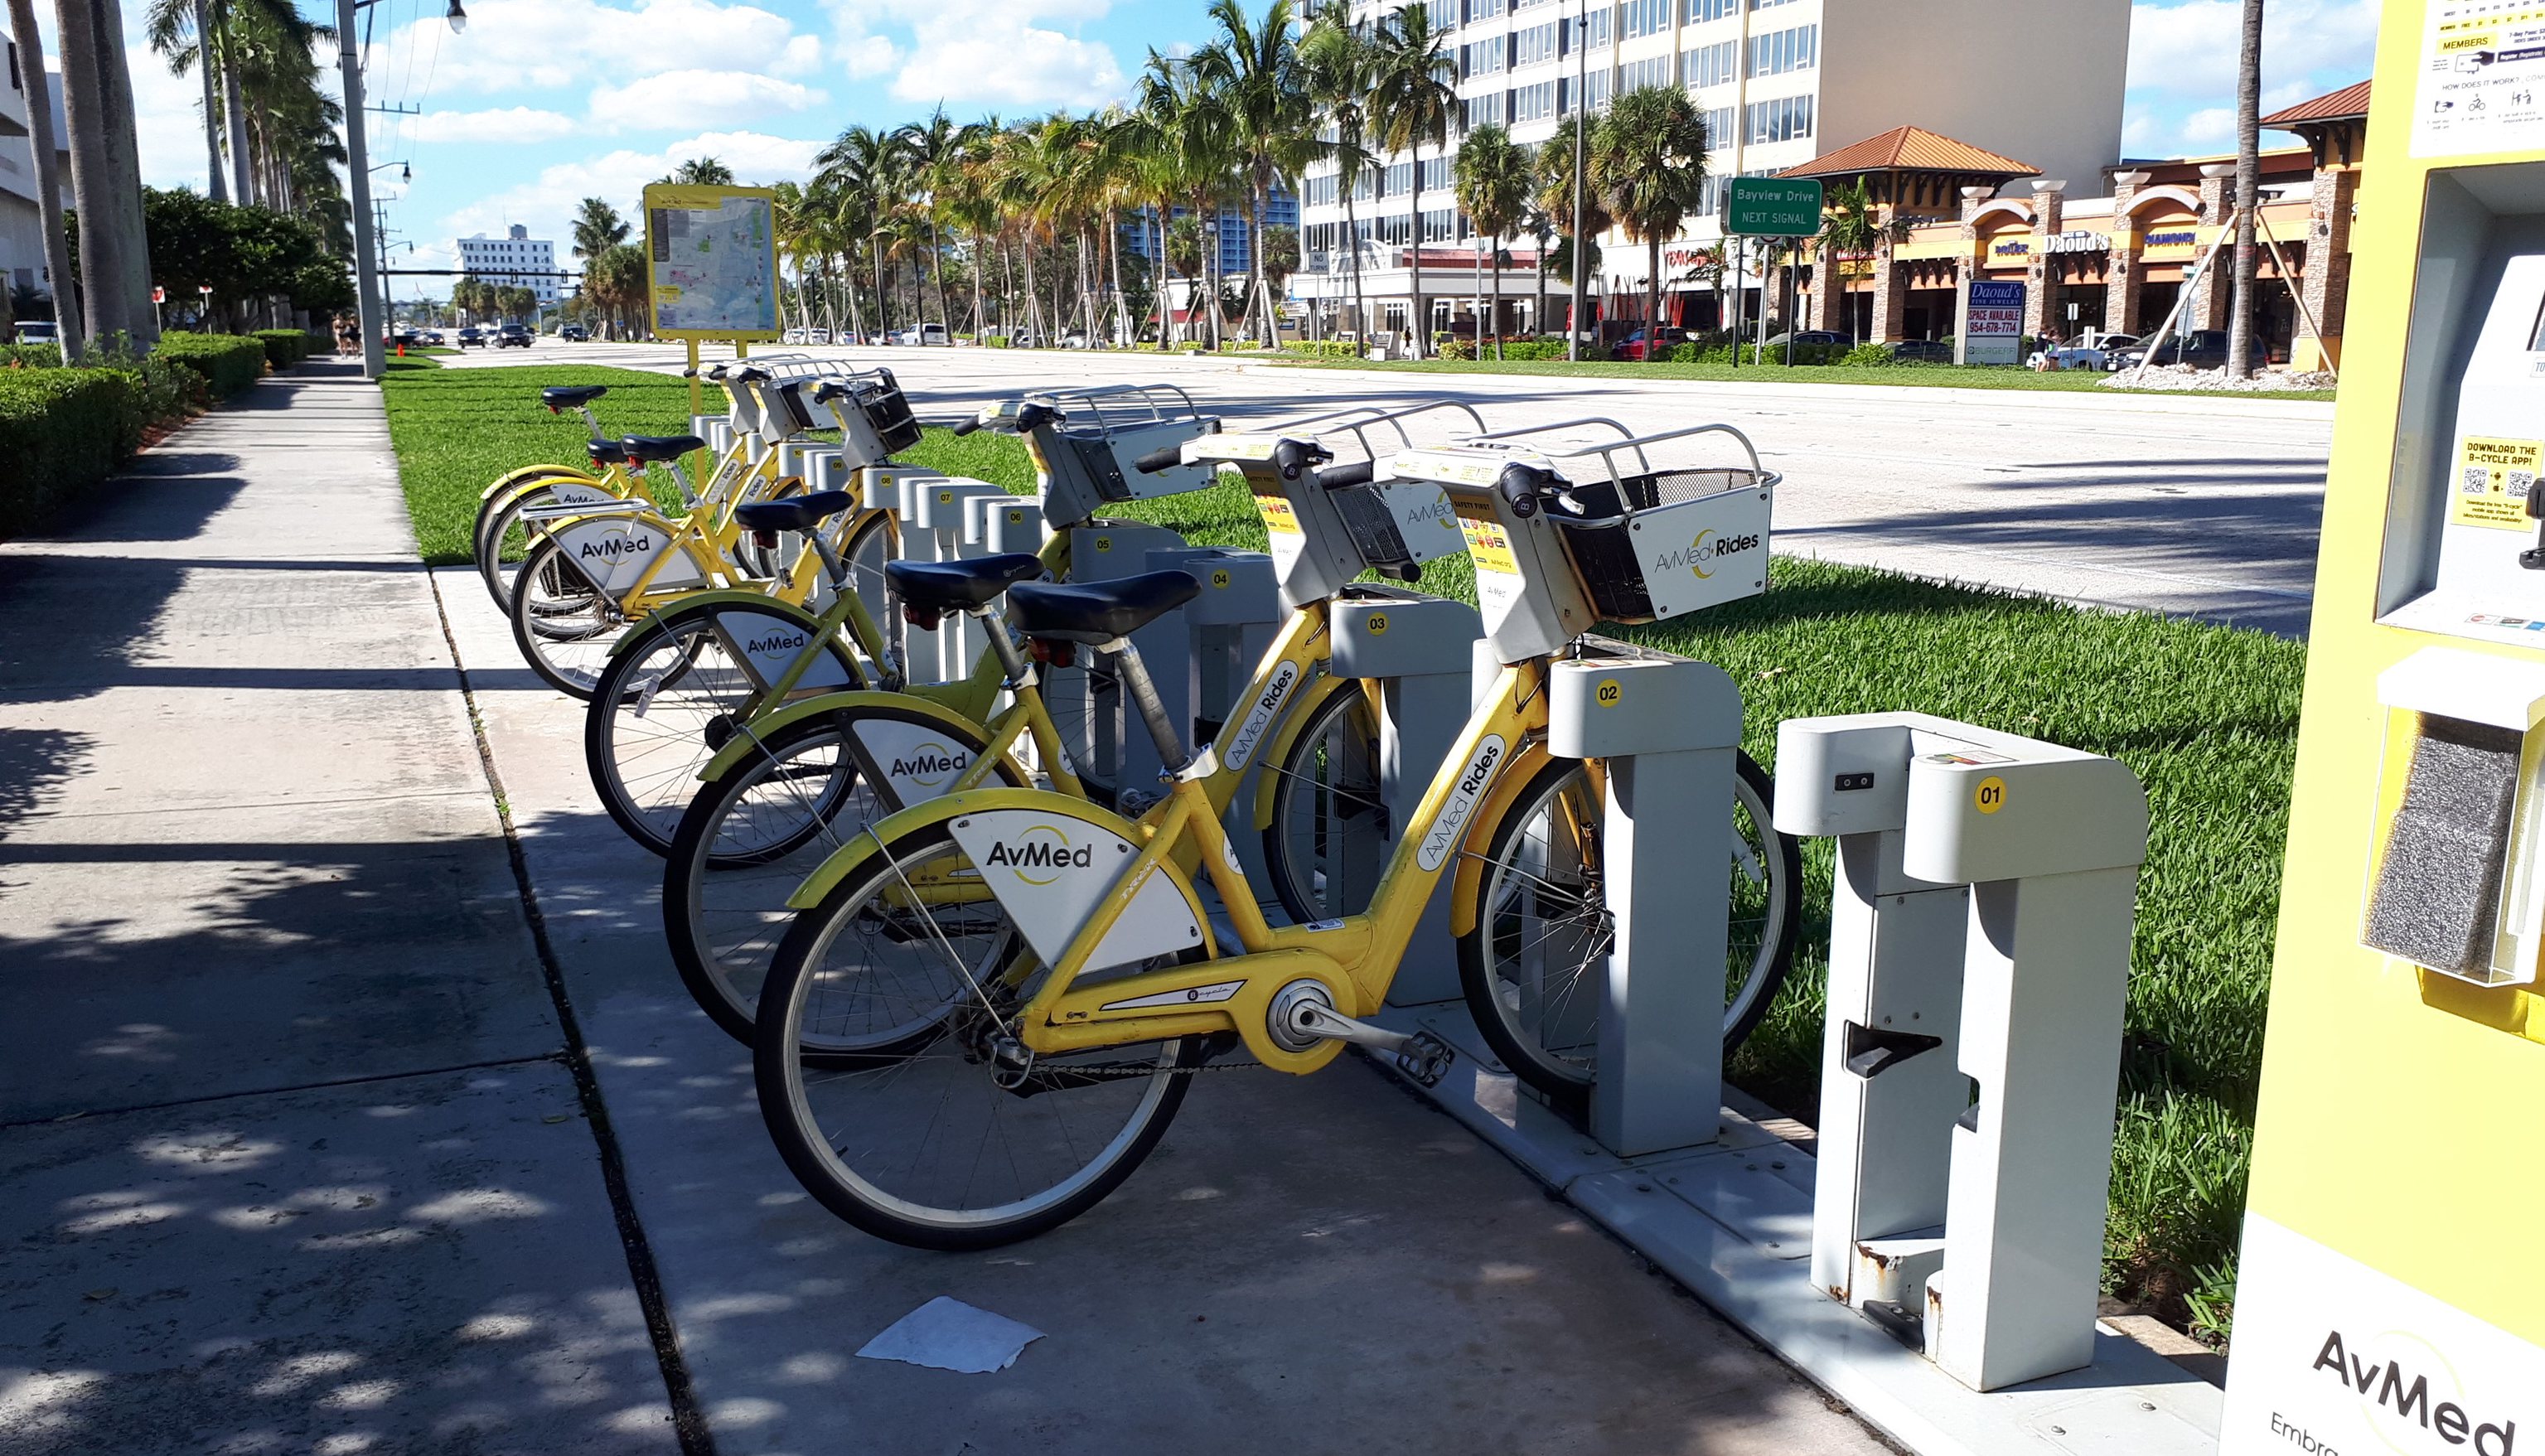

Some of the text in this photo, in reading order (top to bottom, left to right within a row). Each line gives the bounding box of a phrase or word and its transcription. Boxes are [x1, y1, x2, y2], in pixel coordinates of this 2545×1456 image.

[2443, 37, 2488, 50] MEMBERS
[1737, 189, 1814, 203] Bayview Drive
[1742, 212, 1807, 225] NEXT SIGNAL
[2044, 232, 2109, 253] Daoud's
[1314, 254, 1323, 262] NO
[1972, 283, 2021, 298] Daoud's
[1969, 310, 2020, 321] SPACE AVAILABLE
[1969, 322, 2016, 333] 954-678-7714
[2468, 443, 2537, 456] DOWNLOAD THE
[2469, 453, 2533, 466] B-CYCLE APP!
[723, 462, 736, 480] Rides
[749, 478, 764, 497] Rides
[941, 493, 950, 501] 07
[1454, 501, 1490, 510] SAFETY FIRST
[1520, 502, 1530, 510] B
[1010, 513, 1021, 521] 06
[581, 535, 650, 559] AvMed
[1097, 539, 1109, 549] 05
[1654, 534, 1759, 573] AvMed Rides
[1213, 573, 1227, 583] 04
[1369, 617, 1385, 630] 03
[748, 633, 804, 654] AvMed
[1599, 686, 1618, 701] 02
[1231, 670, 1293, 764] AvMed Rides
[891, 752, 966, 777] AvMed
[966, 754, 997, 786] TREK
[1981, 786, 2000, 804] 01
[1425, 746, 1498, 862] AvMed Rides
[986, 842, 1092, 868] AvMed
[1120, 859, 1157, 900] TREK
[2313, 1330, 2516, 1456] AvMed
